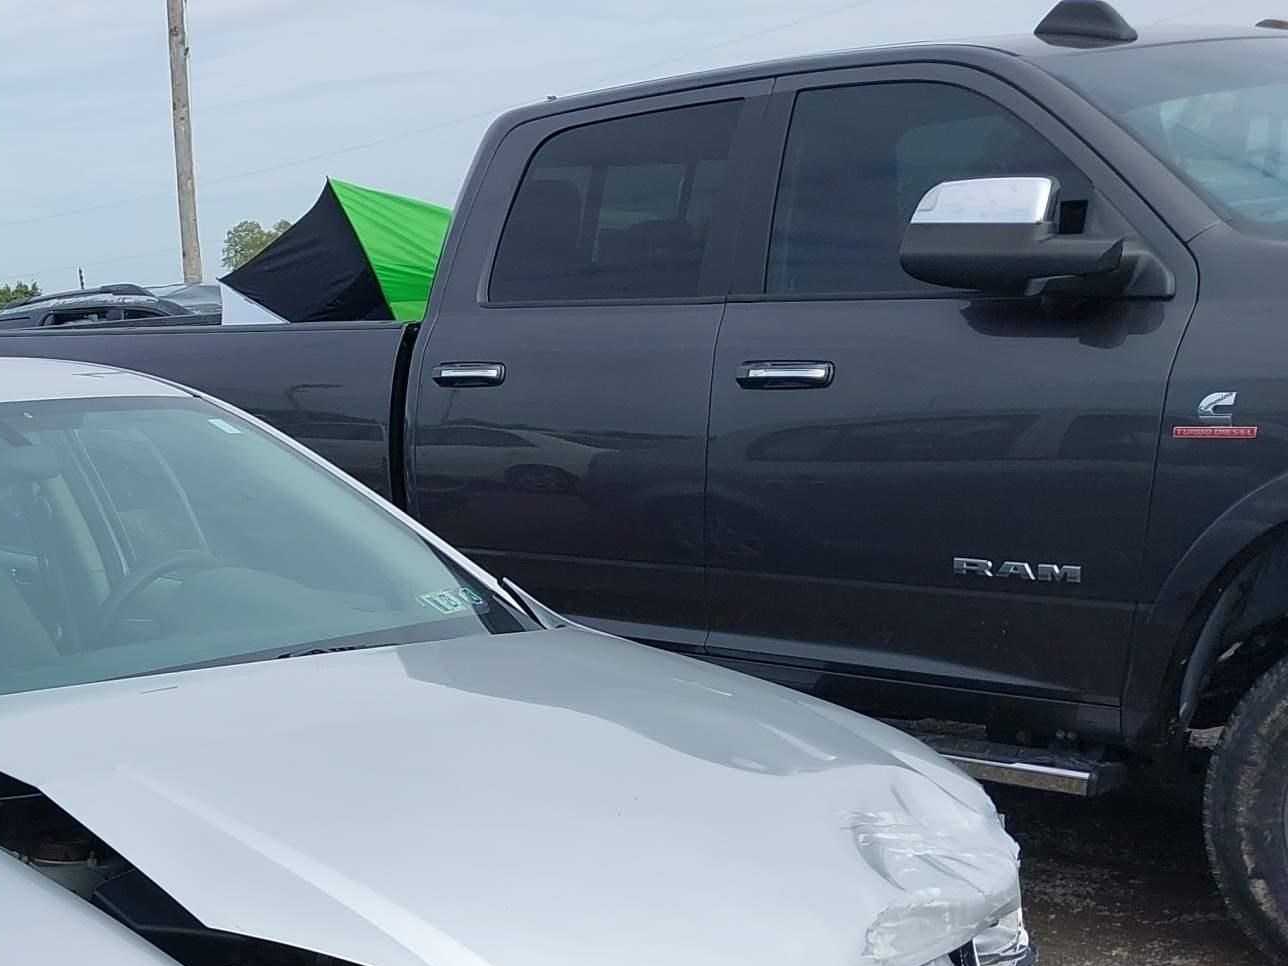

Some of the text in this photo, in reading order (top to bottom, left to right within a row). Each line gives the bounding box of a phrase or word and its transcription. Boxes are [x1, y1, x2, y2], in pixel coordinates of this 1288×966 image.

[1176, 428, 1254, 437] TURBO DIESEL
[953, 557, 1082, 584] RAM
